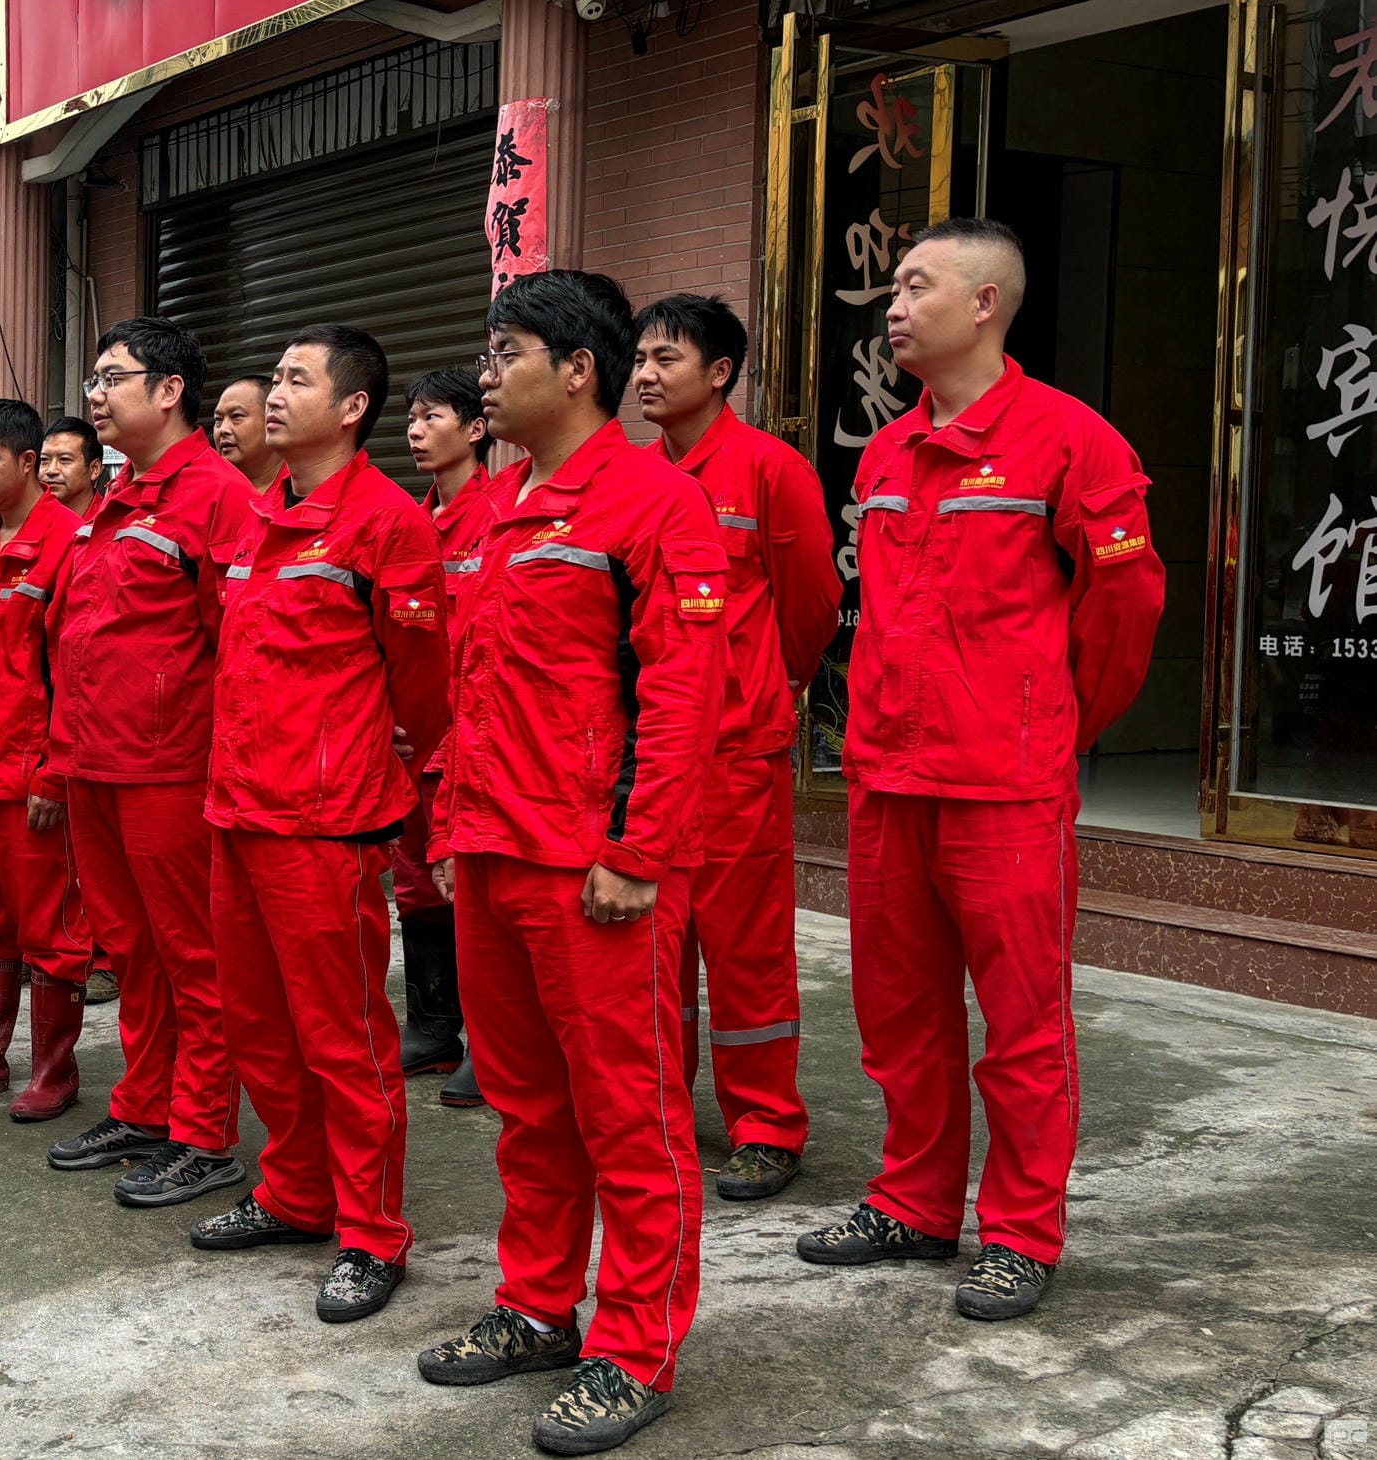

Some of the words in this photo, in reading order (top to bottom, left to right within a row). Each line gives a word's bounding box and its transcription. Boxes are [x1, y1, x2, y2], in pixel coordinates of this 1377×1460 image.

[1095, 535, 1146, 556] 四川资源集团
